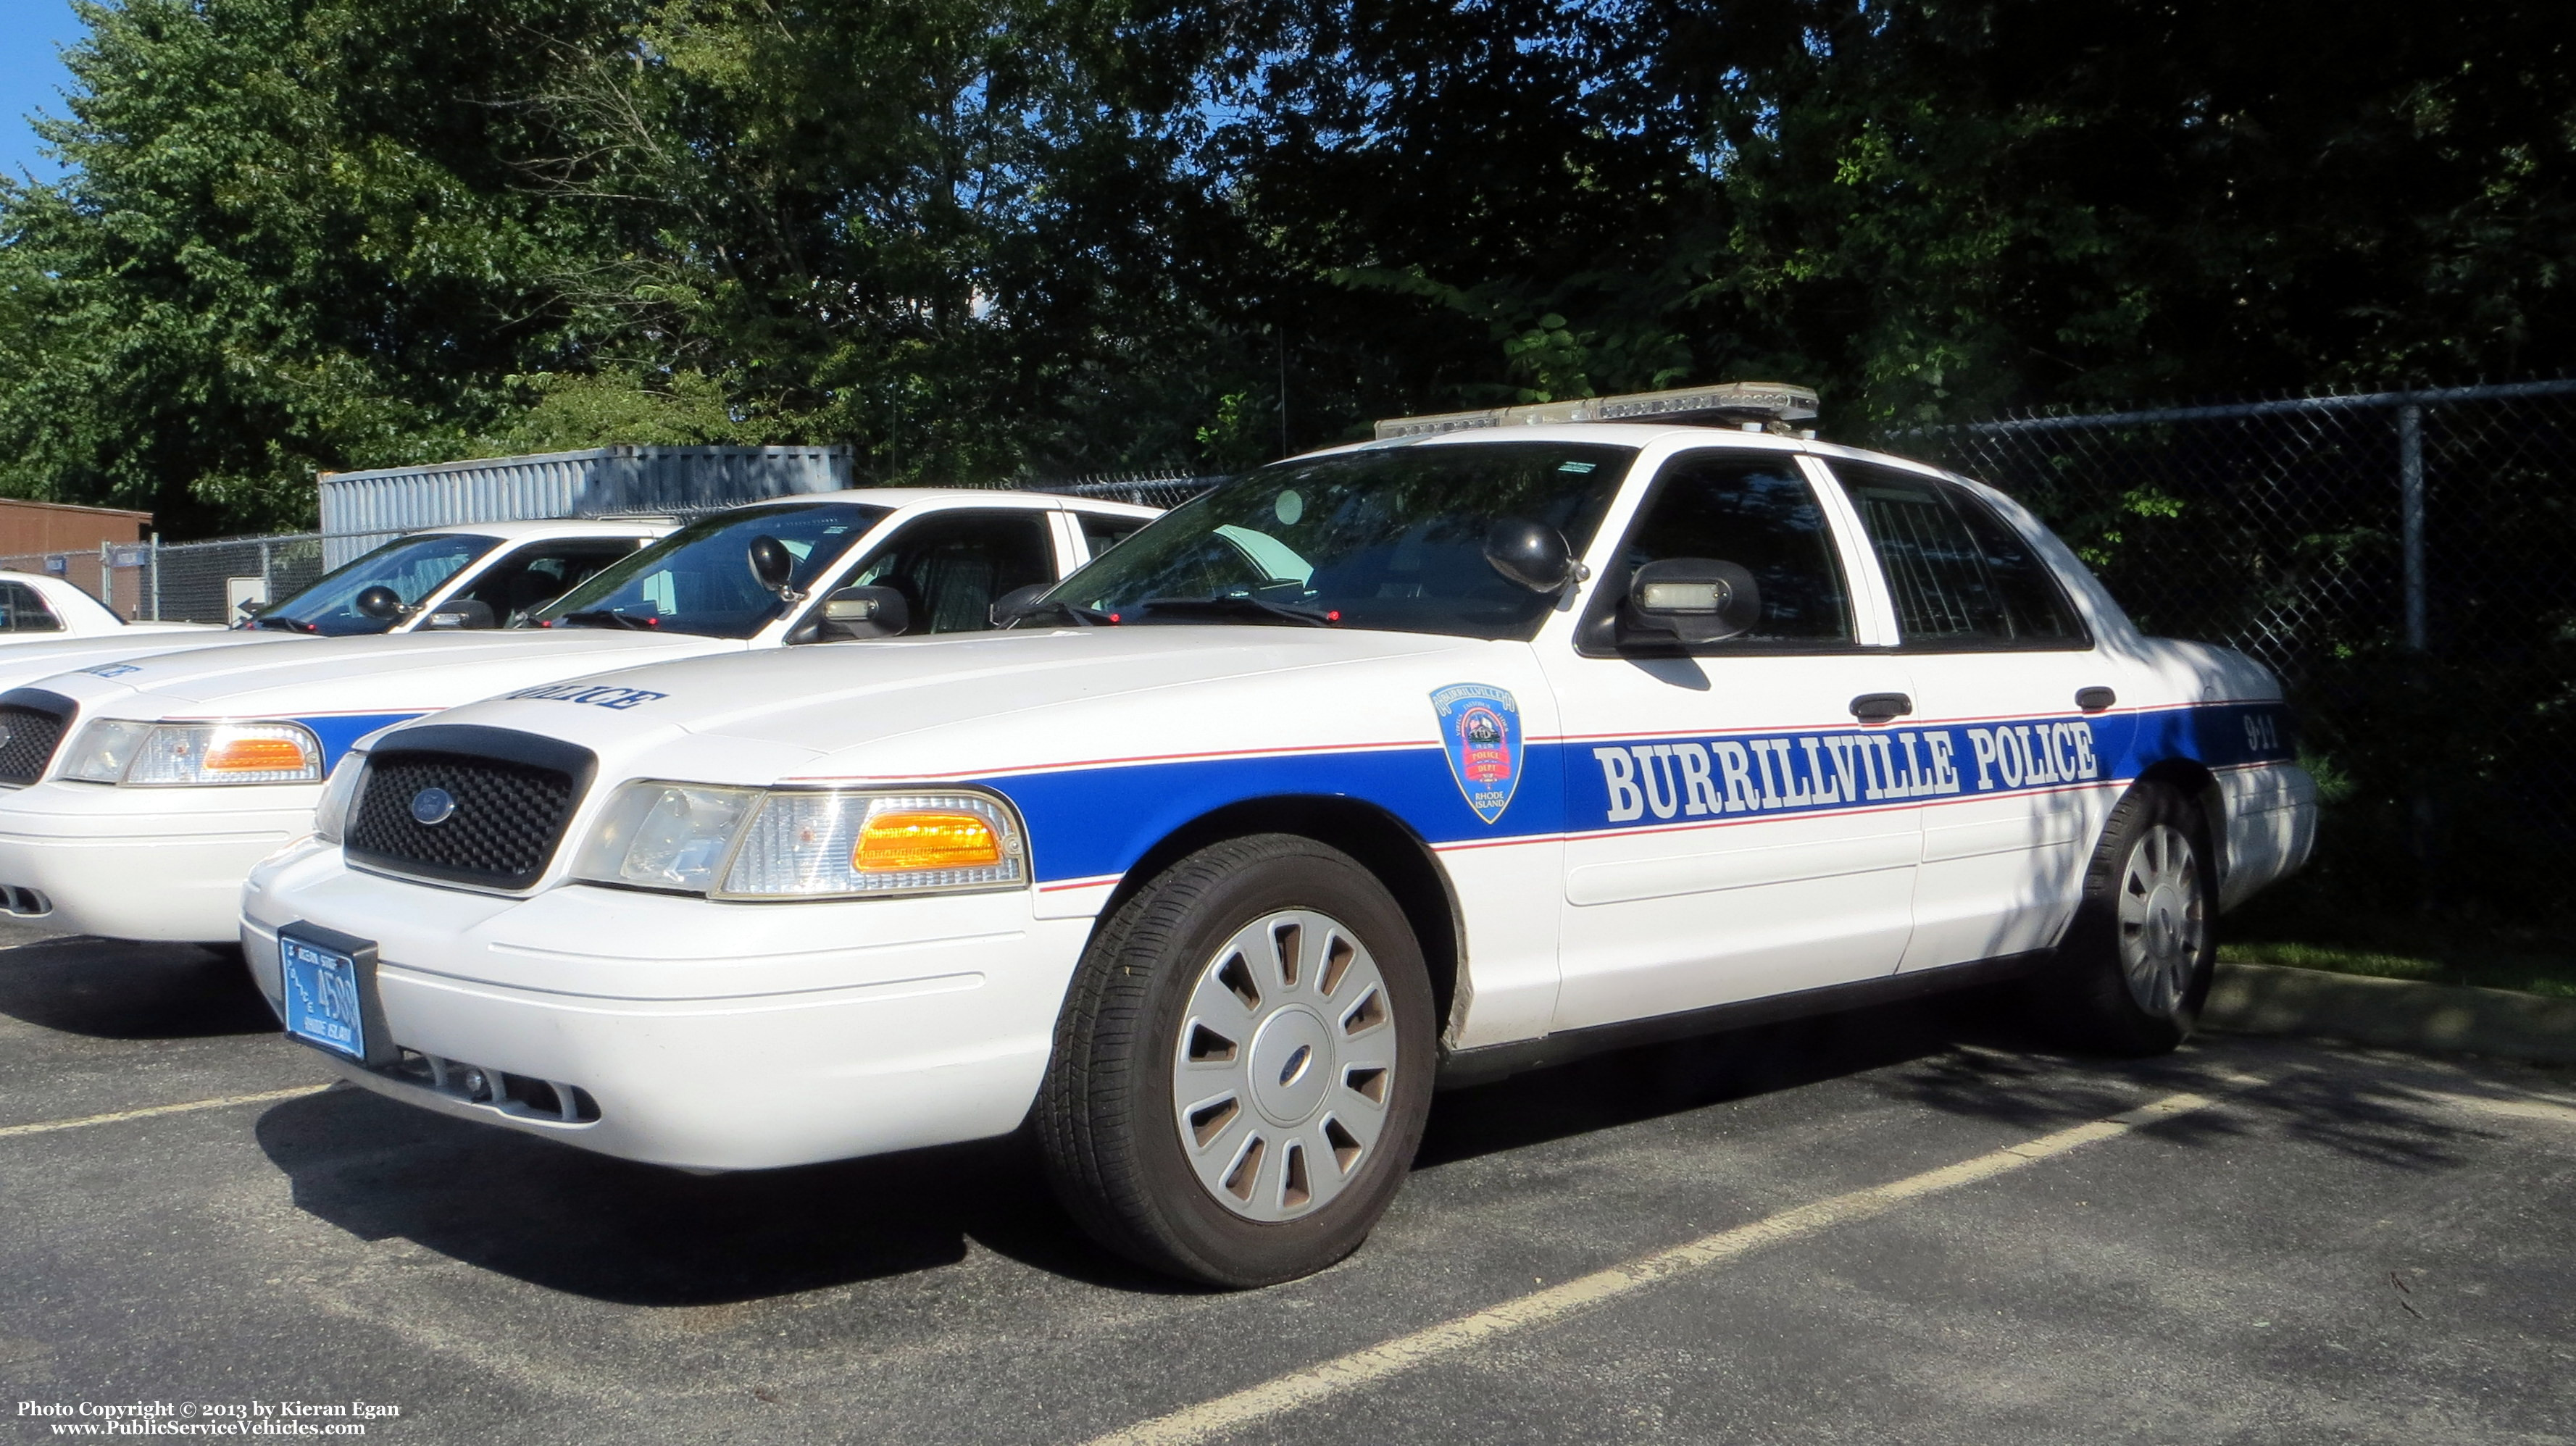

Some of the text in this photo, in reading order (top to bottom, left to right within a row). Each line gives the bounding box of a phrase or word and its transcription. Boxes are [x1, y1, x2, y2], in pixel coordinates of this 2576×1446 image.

[1443, 687, 1504, 701] BURRILLVILLE
[1472, 751, 1499, 760] POLICE
[1594, 722, 2098, 824] BURRILLVILLE POLICE
[1475, 791, 1504, 801] RHODE
[1475, 799, 1505, 810] ISLAND
